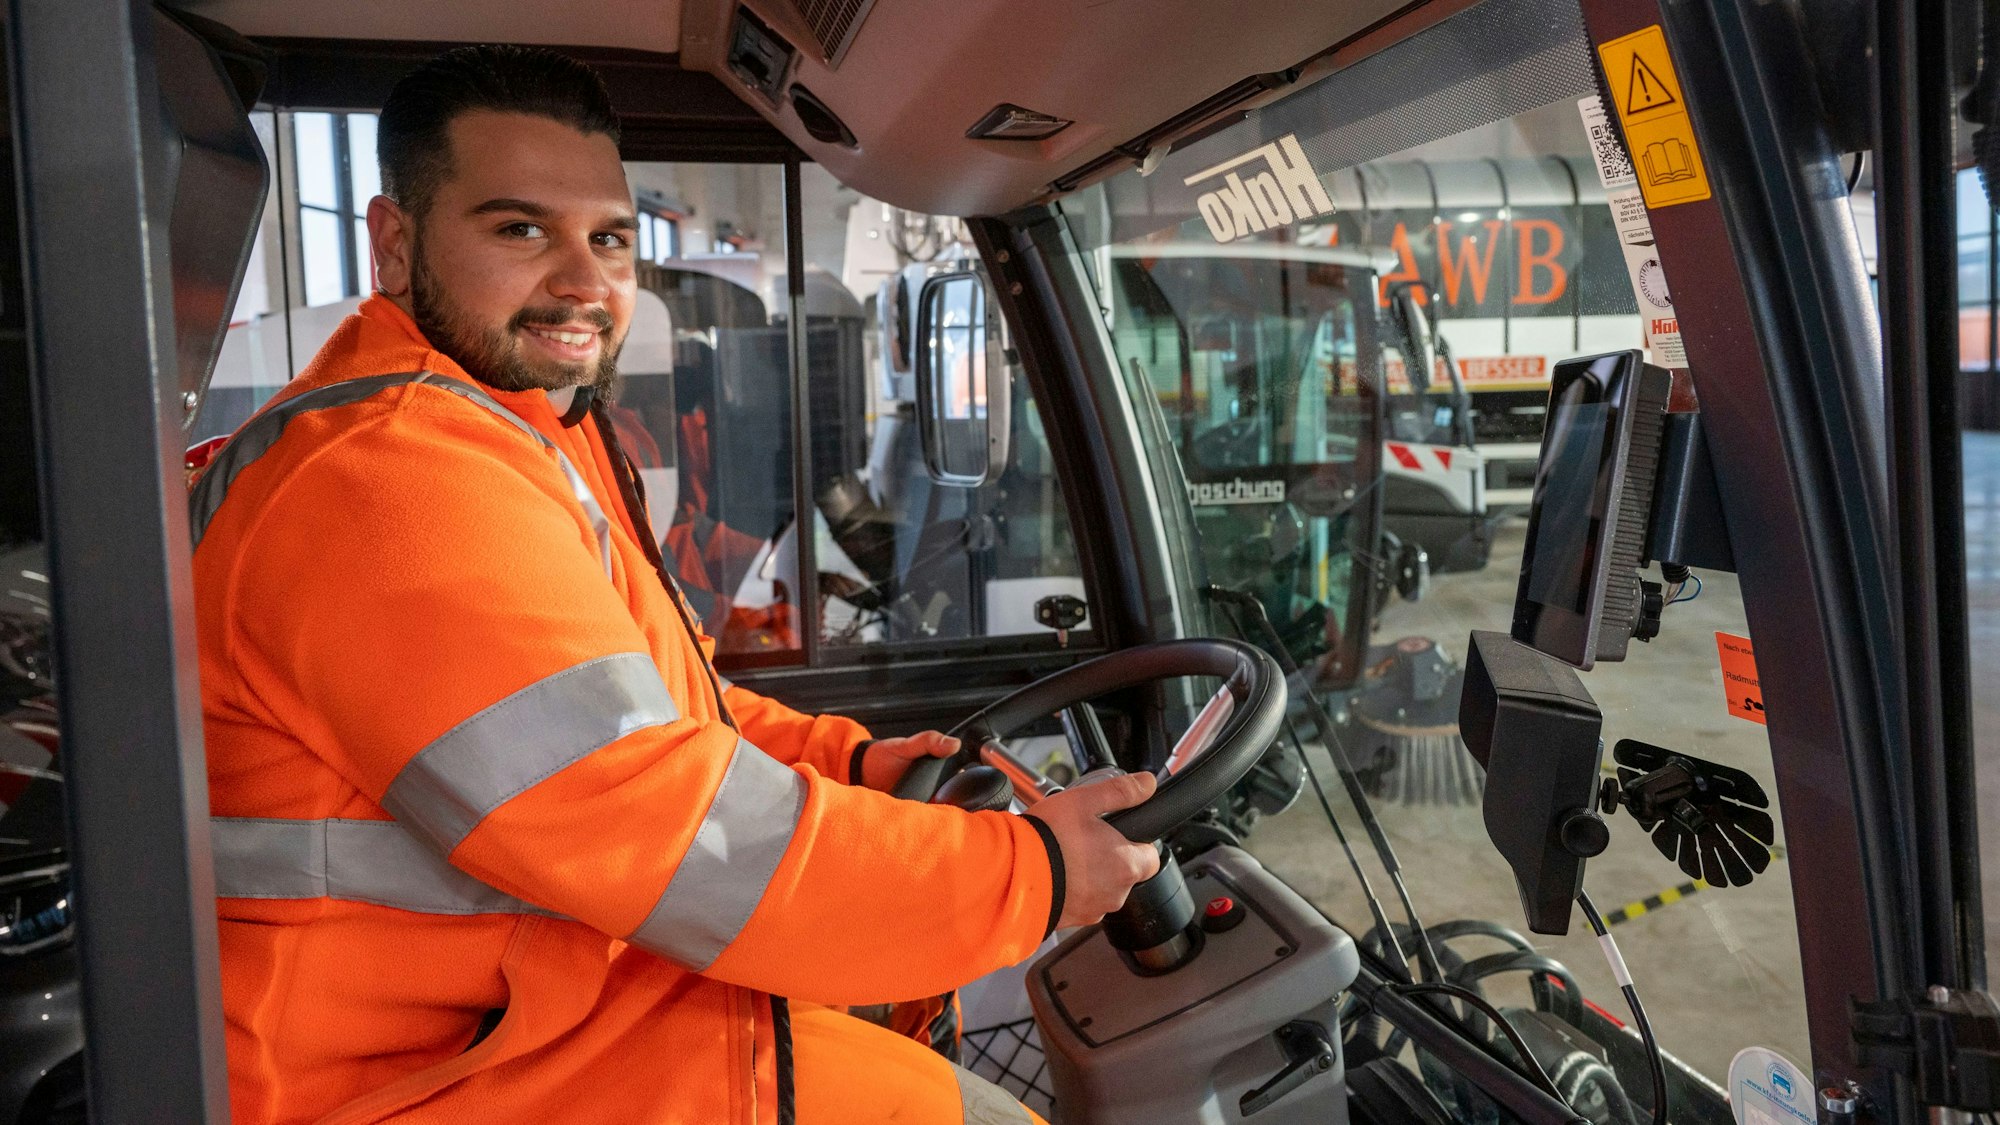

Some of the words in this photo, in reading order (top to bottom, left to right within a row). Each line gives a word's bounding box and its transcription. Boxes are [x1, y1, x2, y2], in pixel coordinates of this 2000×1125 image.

[1614, 196, 1630, 204] Prüfung
[1379, 219, 1567, 308] AWB
[1469, 357, 1543, 379] BESSER
[1723, 643, 1740, 652] Nach
